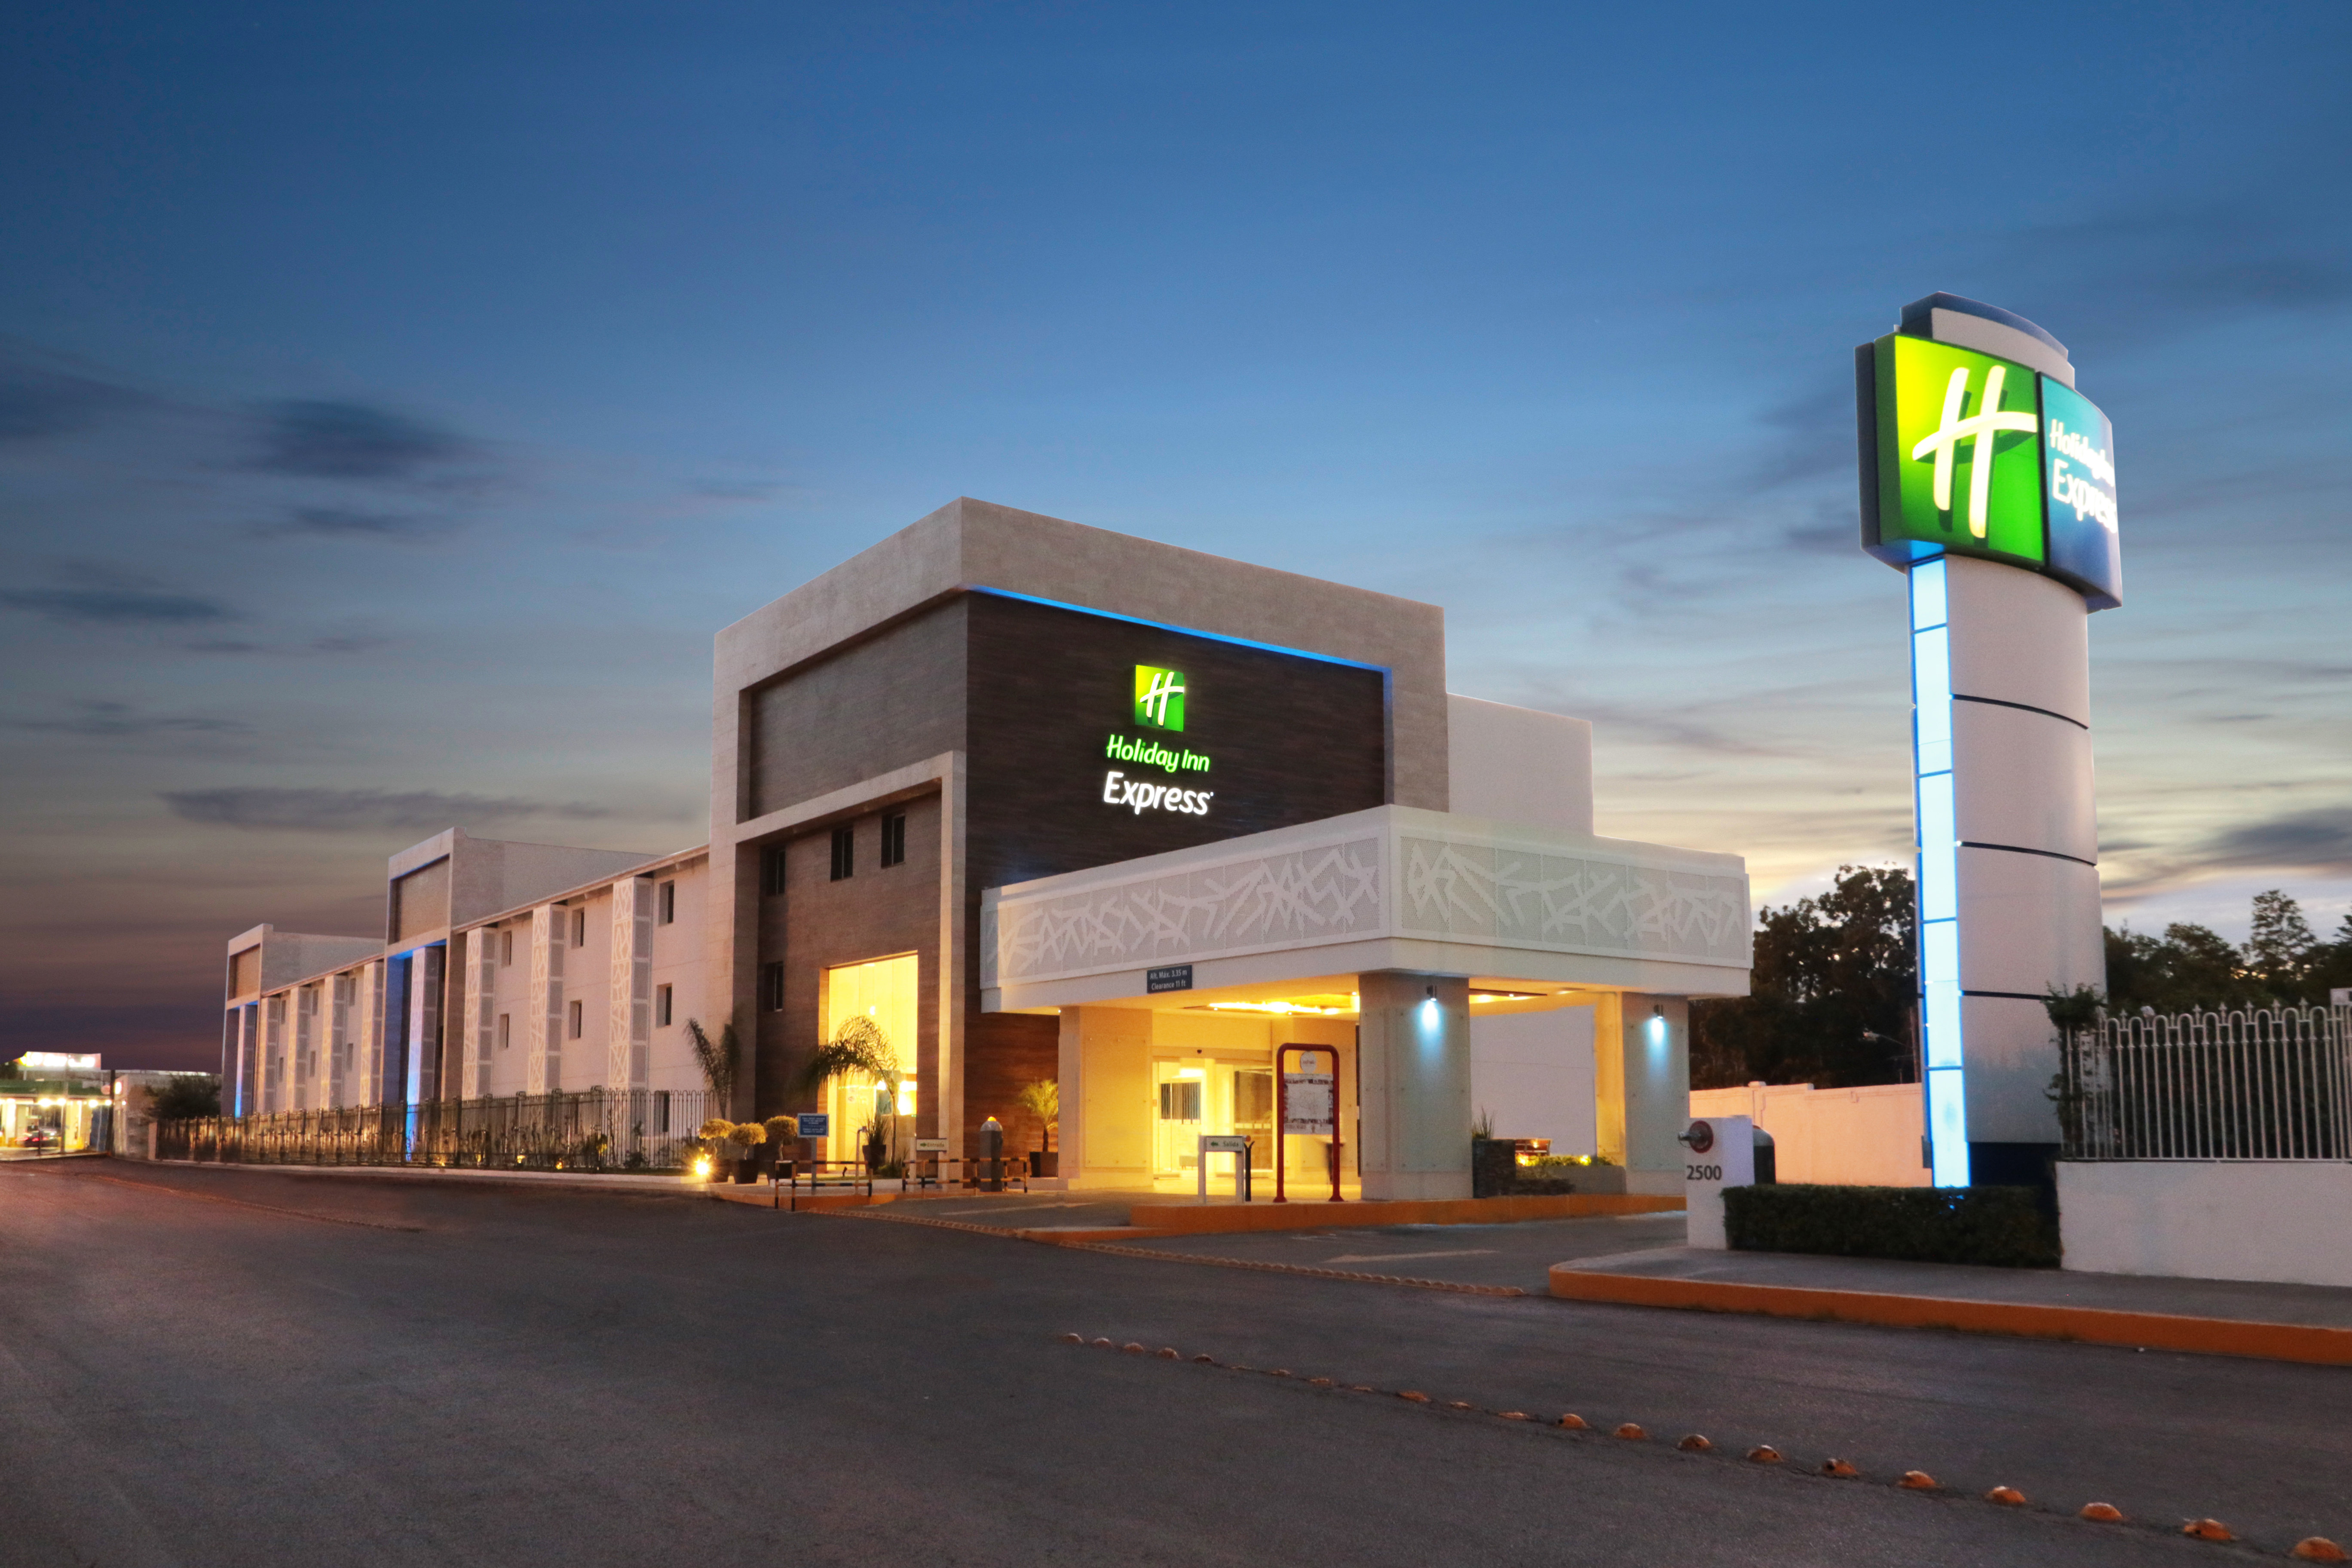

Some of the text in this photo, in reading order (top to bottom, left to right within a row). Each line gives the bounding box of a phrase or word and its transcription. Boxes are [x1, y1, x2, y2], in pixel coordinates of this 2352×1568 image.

[1106, 734, 1210, 773] Holiday Inn
[1103, 771, 1211, 815] Express
[1171, 969, 1182, 977] 3.35
[1151, 982, 1175, 990] Clearance
[1687, 1165, 1722, 1181] 2500
